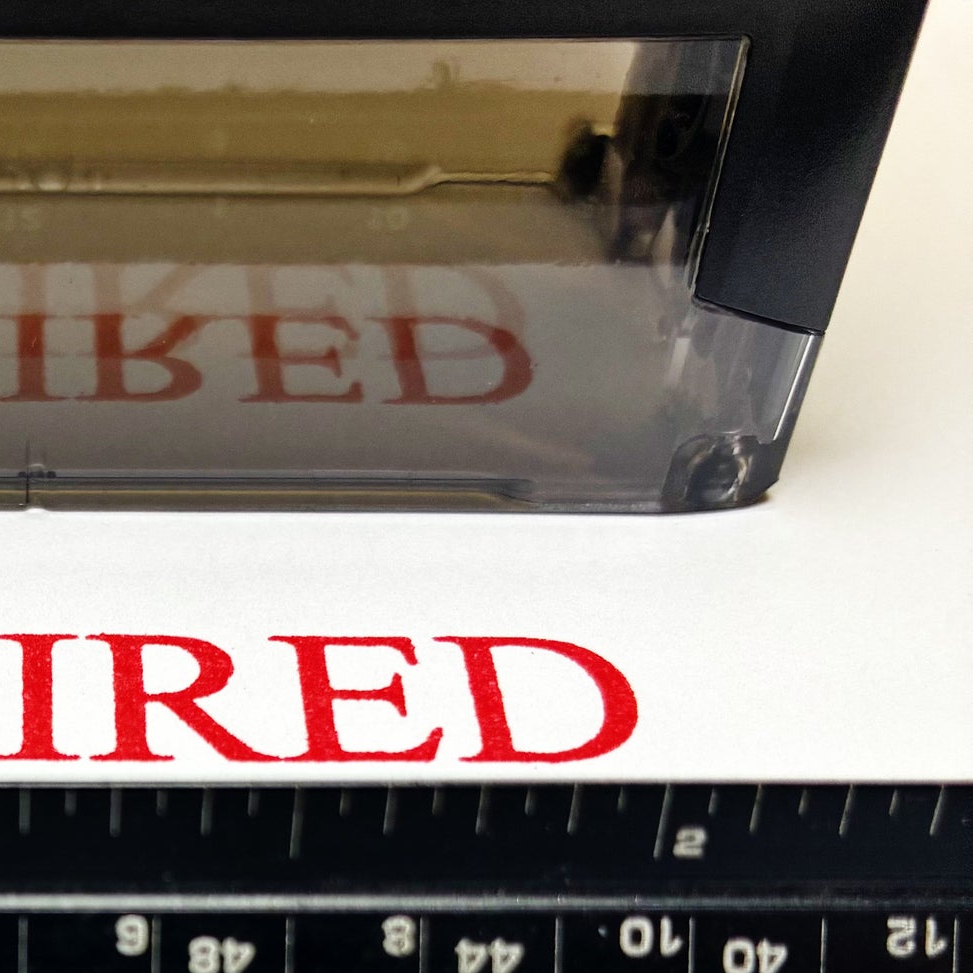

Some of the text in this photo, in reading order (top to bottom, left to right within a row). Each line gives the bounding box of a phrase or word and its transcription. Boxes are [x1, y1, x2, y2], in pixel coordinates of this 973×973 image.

[672, 827, 707, 857] 2
[115, 913, 149, 956] 6
[381, 914, 416, 957] 8
[618, 915, 684, 958] 10
[885, 916, 948, 958] 12
